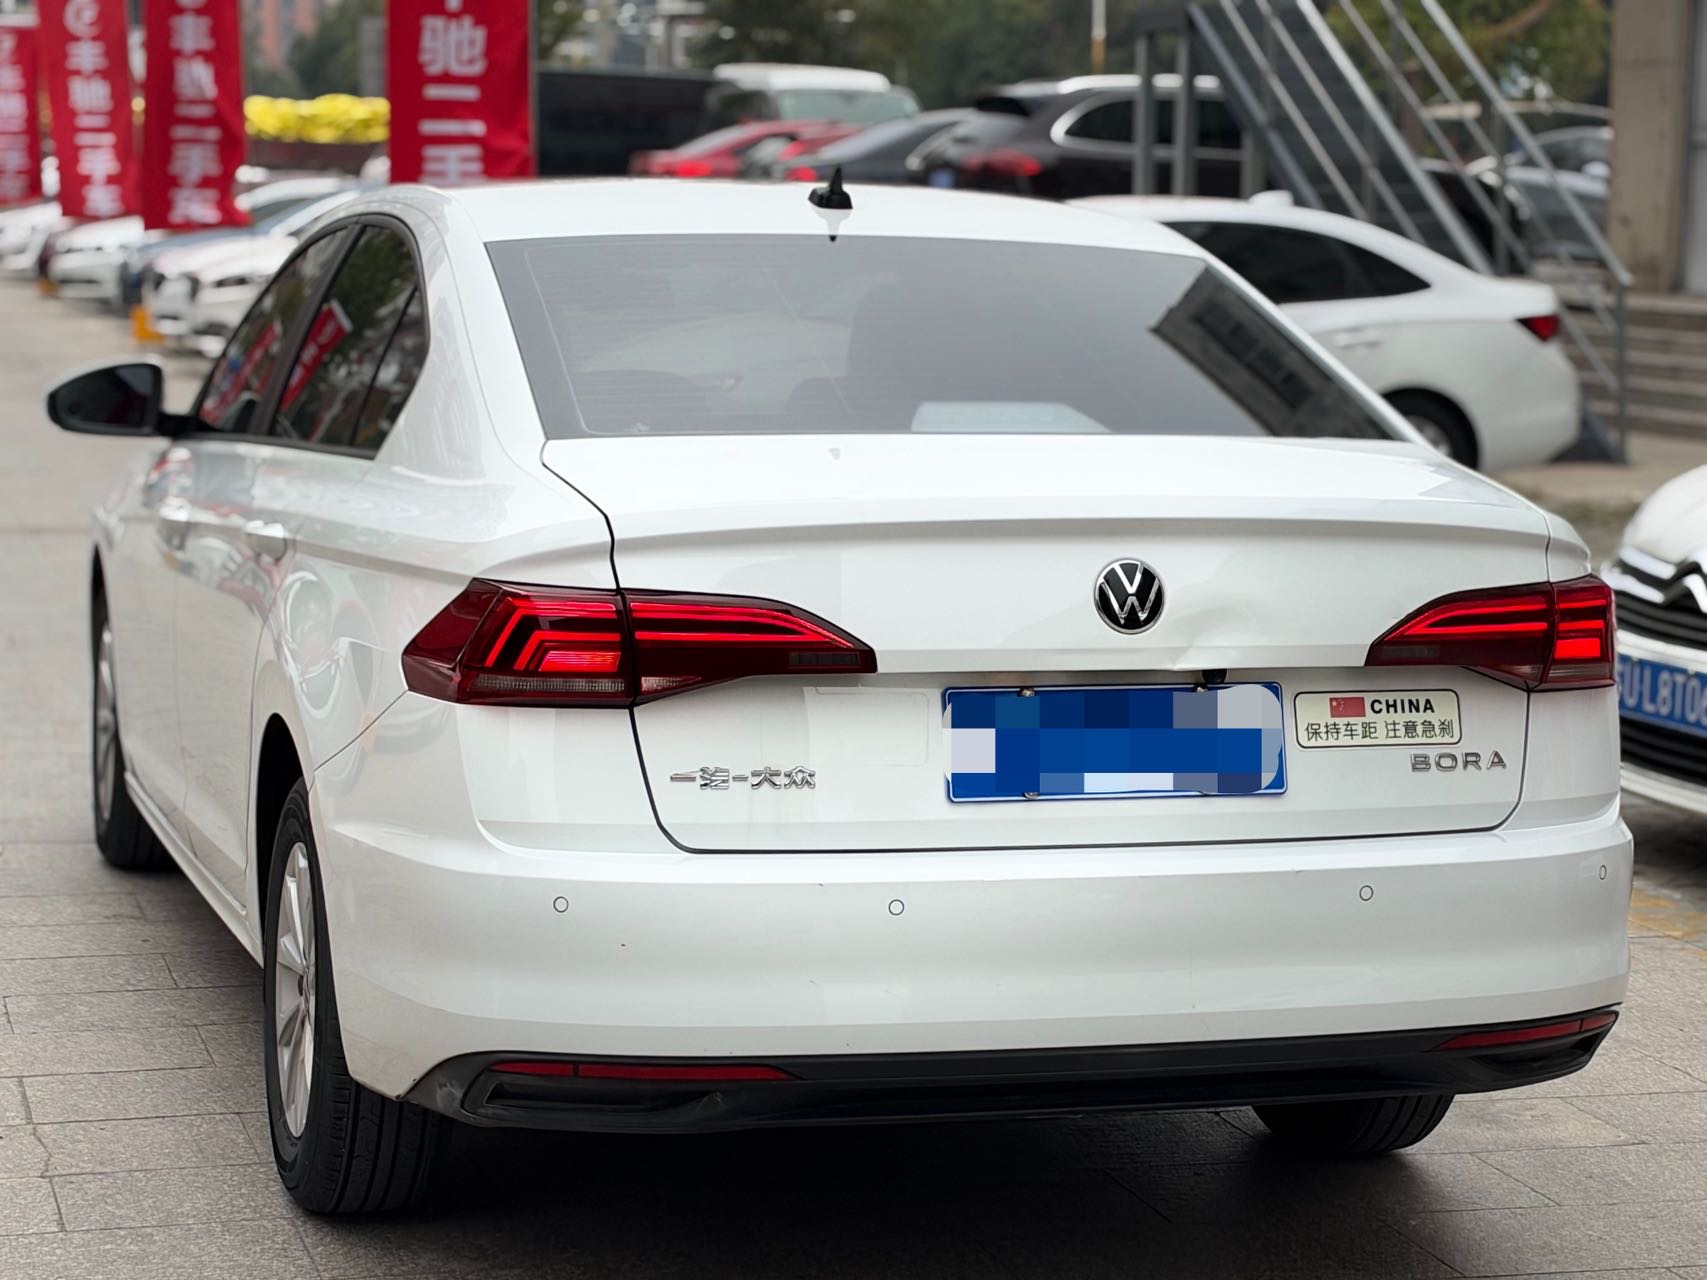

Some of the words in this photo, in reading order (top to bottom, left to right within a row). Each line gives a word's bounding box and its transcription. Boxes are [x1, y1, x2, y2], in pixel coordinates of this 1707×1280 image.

[417, 0, 489, 187] 驰二手
[1370, 697, 1436, 715] CHINA
[1304, 721, 1379, 742] 保持车距
[1384, 718, 1455, 740] 注意急刹
[1410, 749, 1508, 773] BORA
